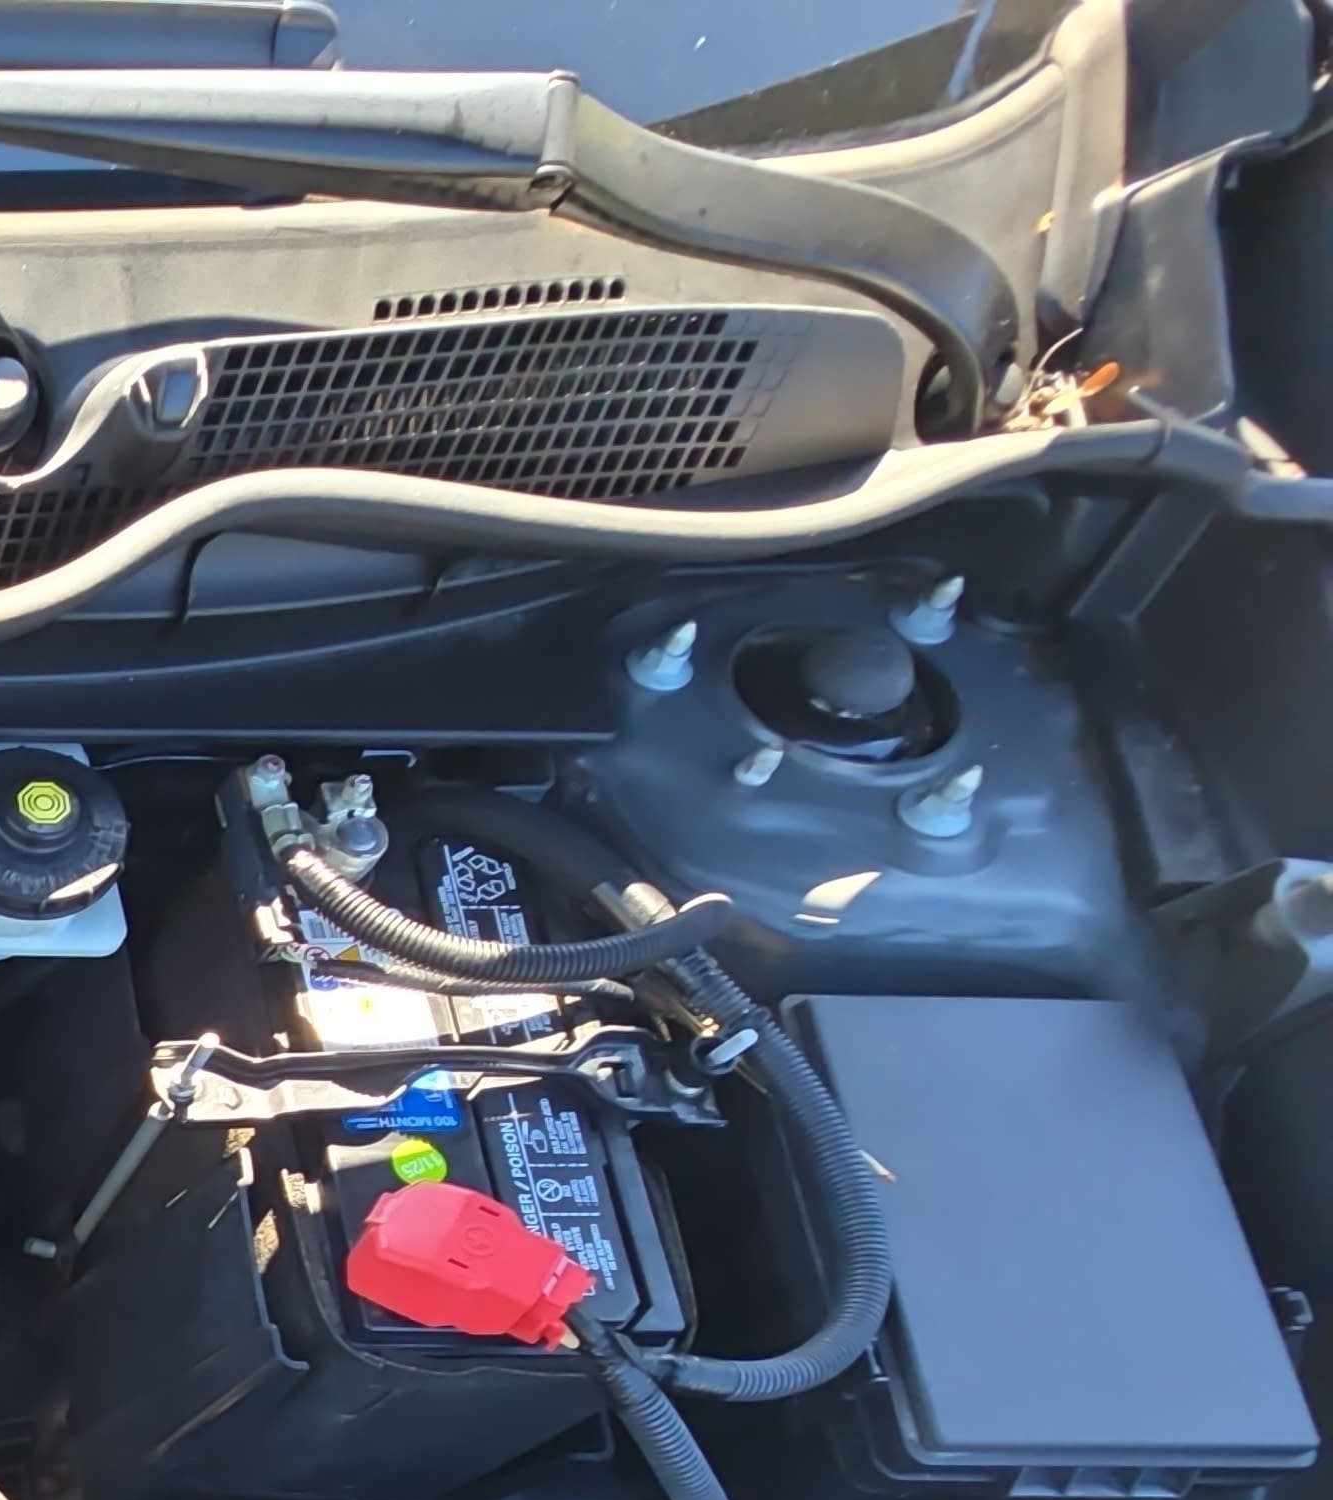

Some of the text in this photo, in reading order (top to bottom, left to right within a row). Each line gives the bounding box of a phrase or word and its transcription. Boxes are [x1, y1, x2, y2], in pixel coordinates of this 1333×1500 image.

[379, 1116, 458, 1127] 100 MONTH
[401, 1152, 445, 1179] 11/25
[499, 1122, 527, 1179] POISON
[518, 1194, 542, 1236] NGER
